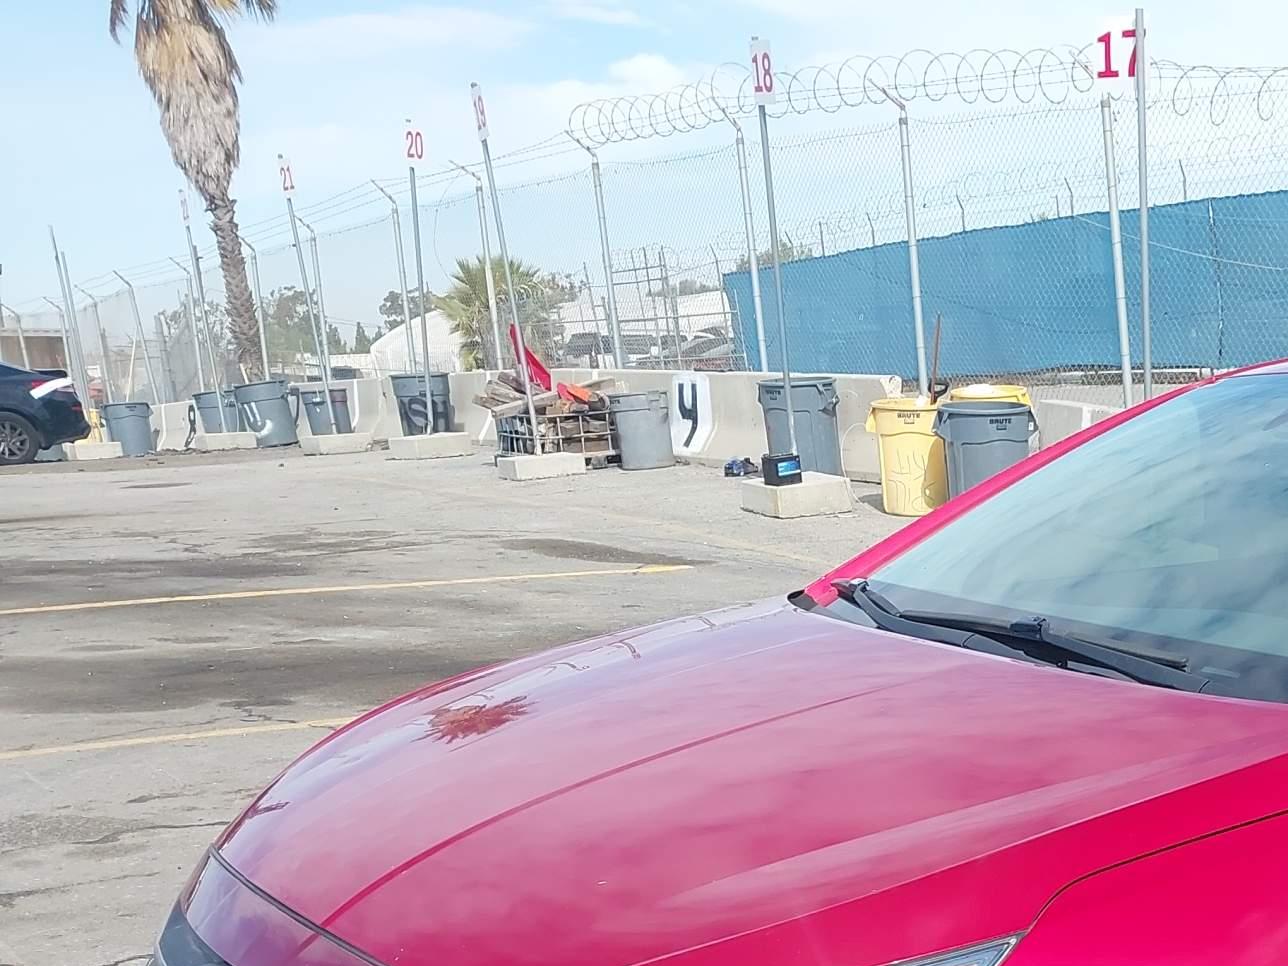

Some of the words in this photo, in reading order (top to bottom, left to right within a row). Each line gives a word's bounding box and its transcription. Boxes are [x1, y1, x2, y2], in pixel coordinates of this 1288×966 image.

[1097, 29, 1146, 78] 17
[752, 52, 773, 93] 18
[474, 95, 487, 131] 19
[406, 131, 423, 159] 20
[280, 165, 295, 191] 21
